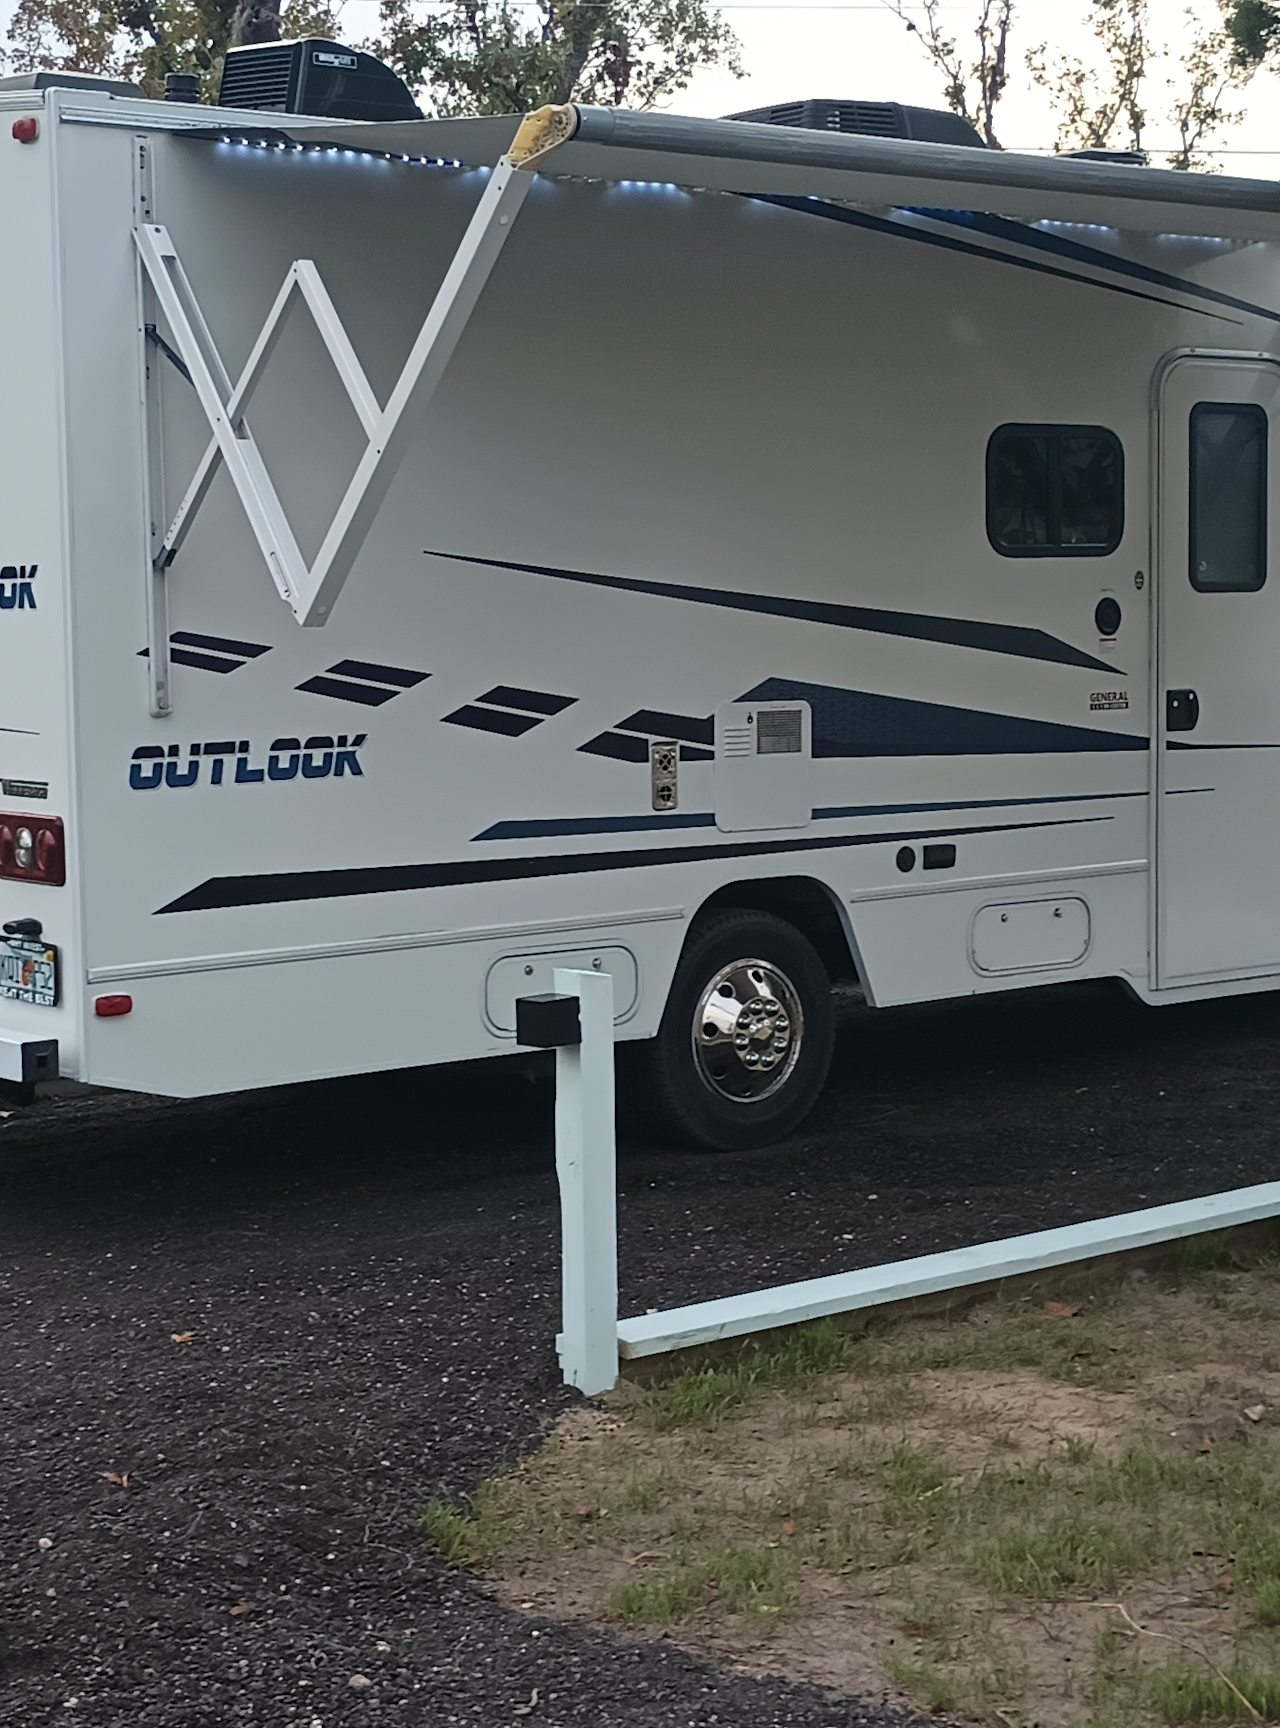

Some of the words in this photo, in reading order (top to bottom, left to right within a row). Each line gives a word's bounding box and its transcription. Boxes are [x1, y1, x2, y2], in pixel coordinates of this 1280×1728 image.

[1090, 691, 1129, 702] GENERAL
[128, 733, 368, 790] OUTLOOK
[35, 994, 55, 1007] BEST
